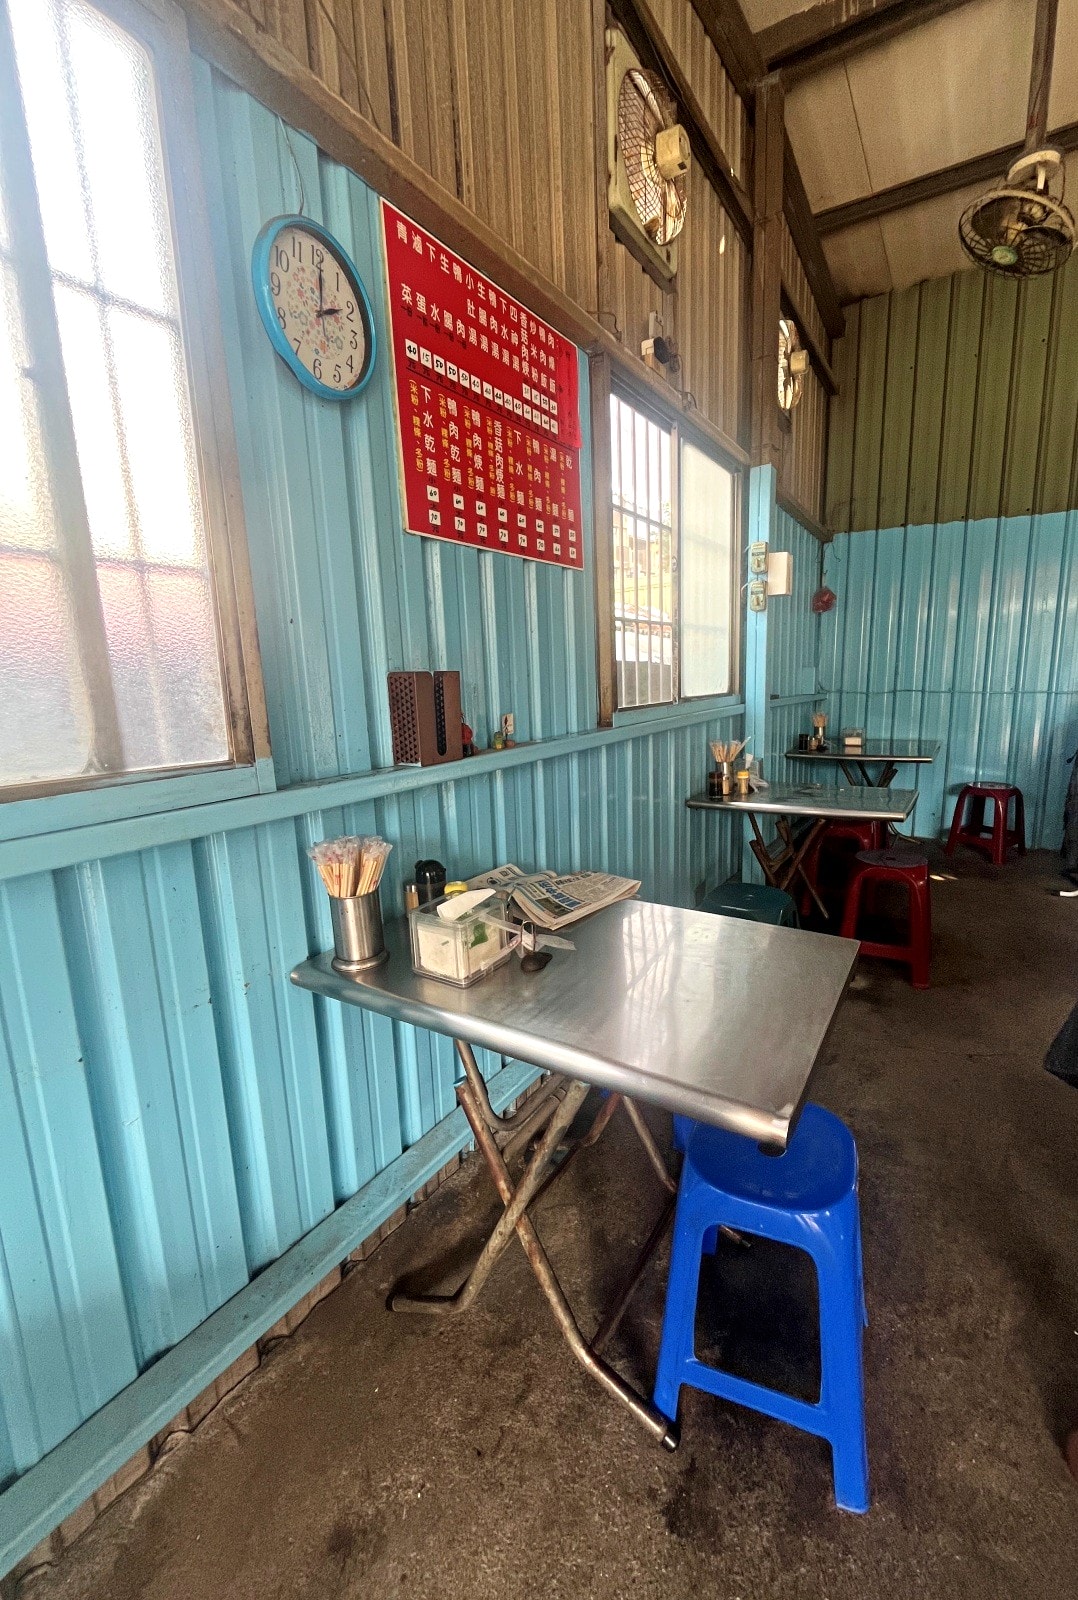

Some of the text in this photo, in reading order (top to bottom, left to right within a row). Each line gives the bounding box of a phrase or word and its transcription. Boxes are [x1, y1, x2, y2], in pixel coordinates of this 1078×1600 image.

[275, 245, 290, 273] 10
[292, 236, 302, 263] 11
[310, 244, 324, 273] 12
[396, 220, 412, 305] 青菜
[270, 272, 281, 297] 9
[335, 272, 340, 293] 1
[425, 242, 440, 321] 下水
[277, 306, 287, 330] 8
[346, 300, 355, 323] 2
[293, 338, 302, 356] 7
[350, 330, 358, 350] 3
[312, 358, 322, 380] 6
[332, 364, 342, 384] 5
[345, 354, 354, 374] 4
